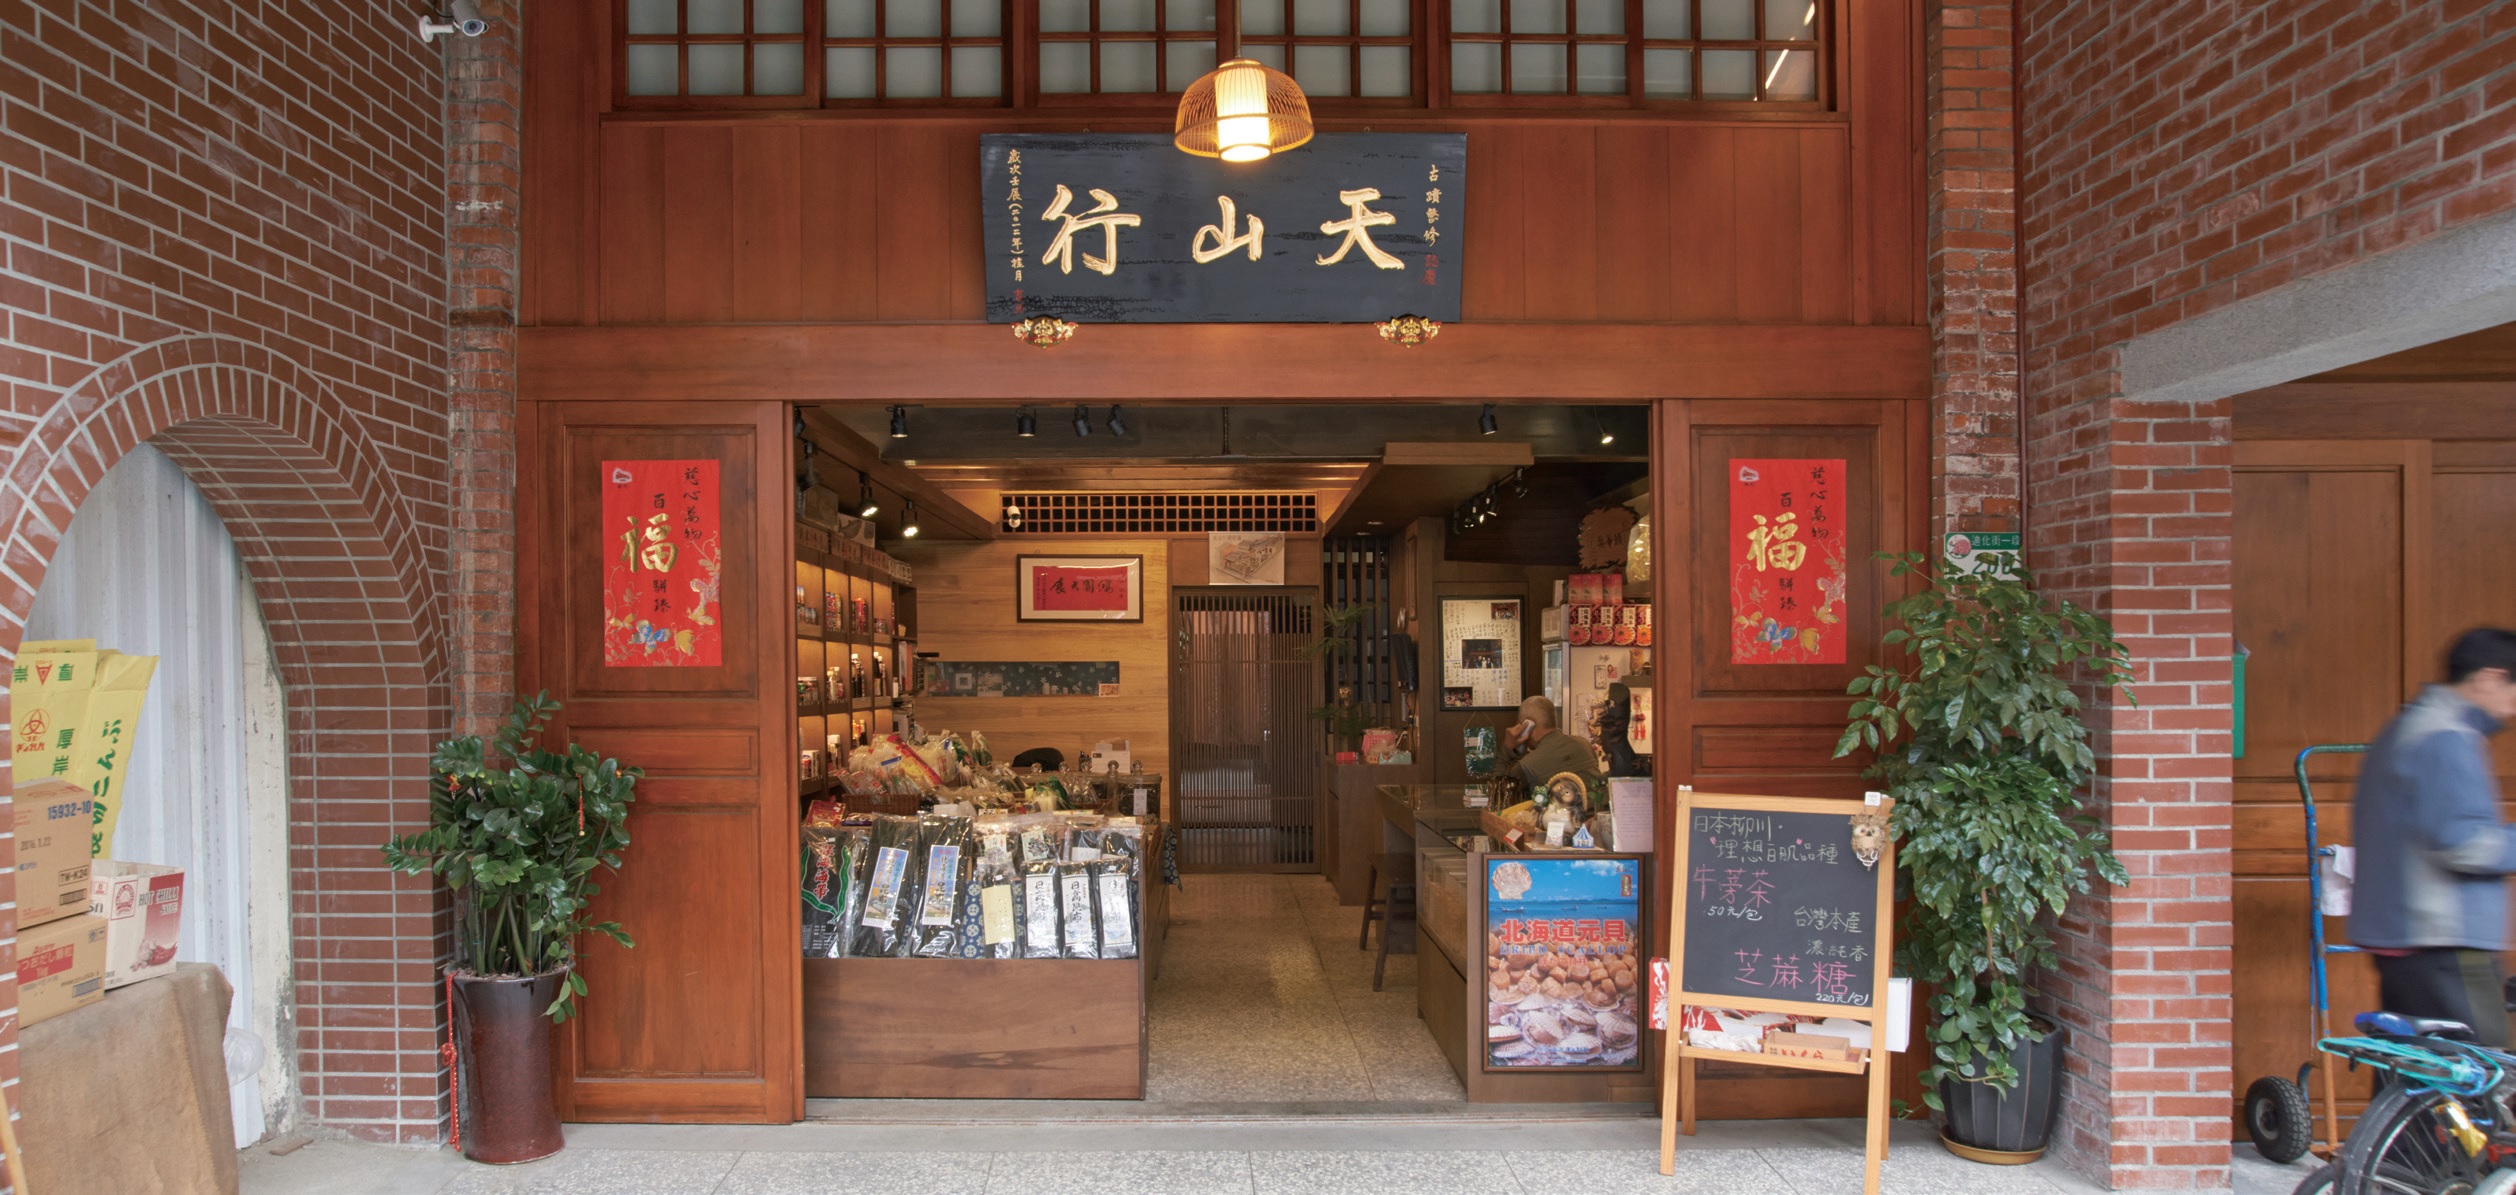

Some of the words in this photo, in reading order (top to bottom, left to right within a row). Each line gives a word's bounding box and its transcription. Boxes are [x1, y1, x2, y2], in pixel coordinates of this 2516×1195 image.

[1042, 183, 1405, 276] 天山行
[1971, 535, 2020, 547] 迪化街一段
[47, 800, 92, 820] 15932-10
[1692, 863, 1776, 908] 牛蒡茶
[1499, 918, 1626, 943] 北海道元貝
[1499, 945, 1548, 955] DRIED
[1558, 945, 1628, 955] SCALLOP
